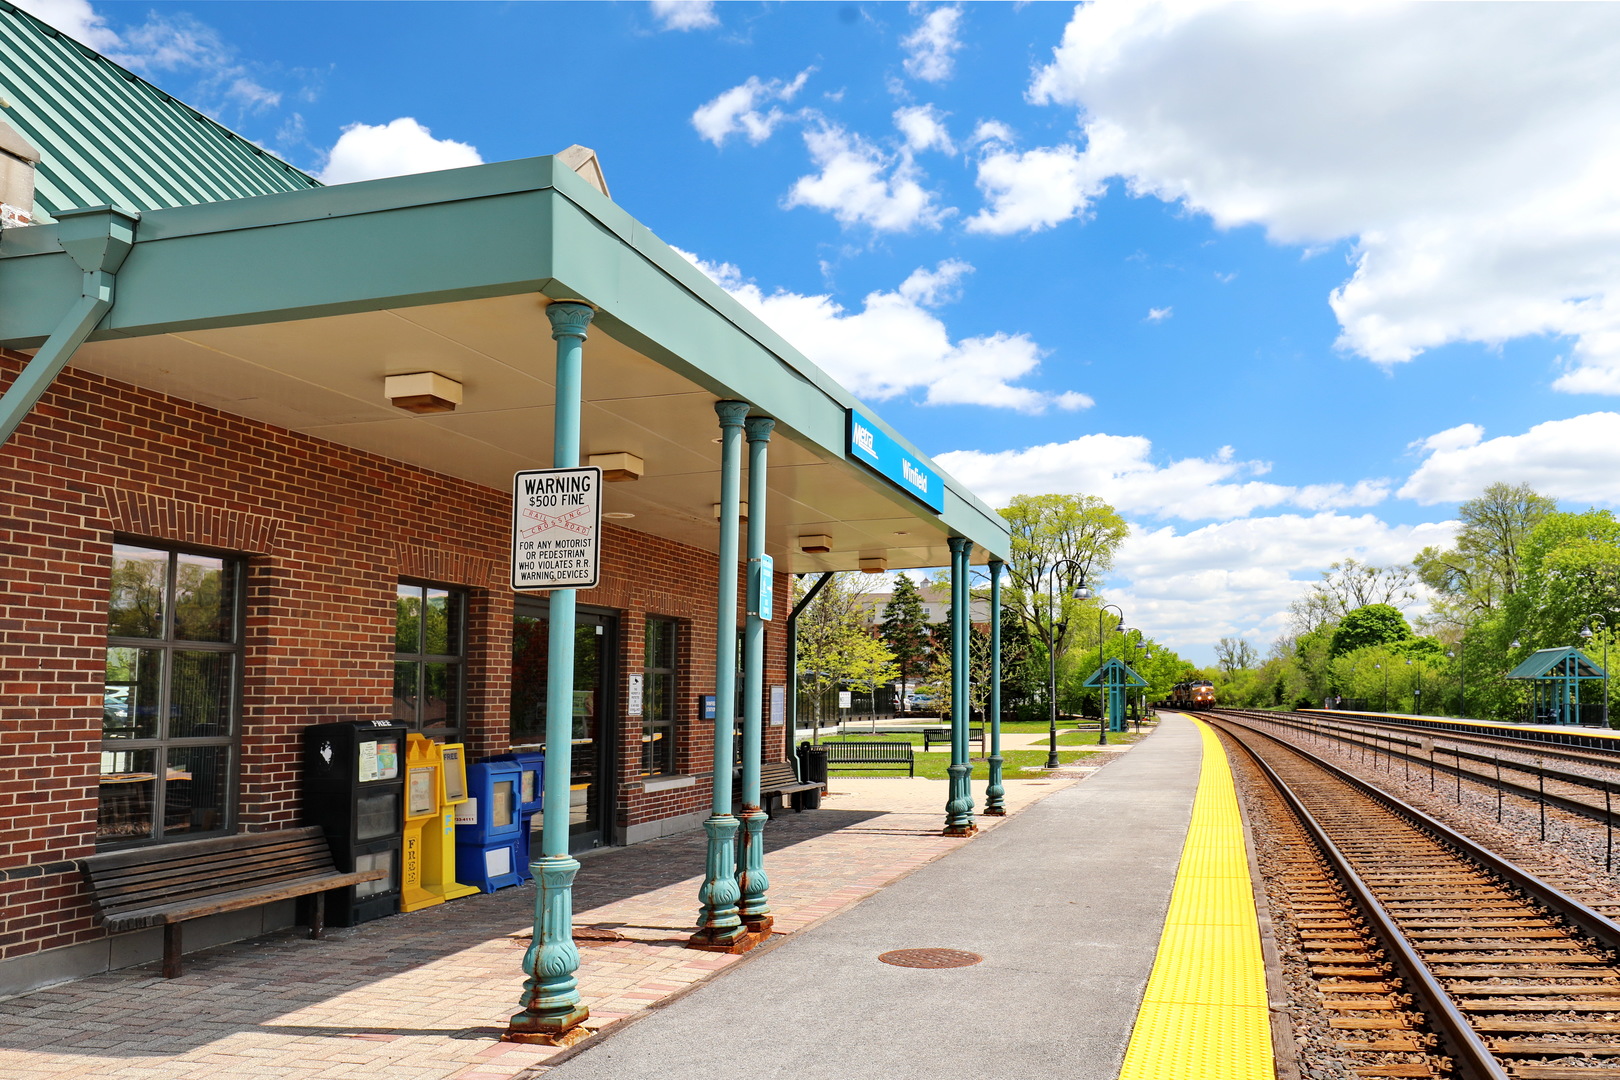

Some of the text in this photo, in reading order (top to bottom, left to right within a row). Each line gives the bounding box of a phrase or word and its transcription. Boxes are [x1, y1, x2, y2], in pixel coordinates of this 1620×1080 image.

[853, 422, 873, 448] Metra
[902, 458, 927, 493] Winfield
[524, 475, 591, 495] WARNING
[529, 493, 585, 507] $500 FINE
[531, 509, 582, 534] CROSSING
[519, 538, 592, 550] FOR ANY MOTORIST
[526, 549, 585, 560] OR PEDESTRIAN
[518, 559, 591, 570] WHO VIOLATES R.R.
[521, 569, 589, 580] WARNING DEVICES
[408, 839, 416, 883] FREE
